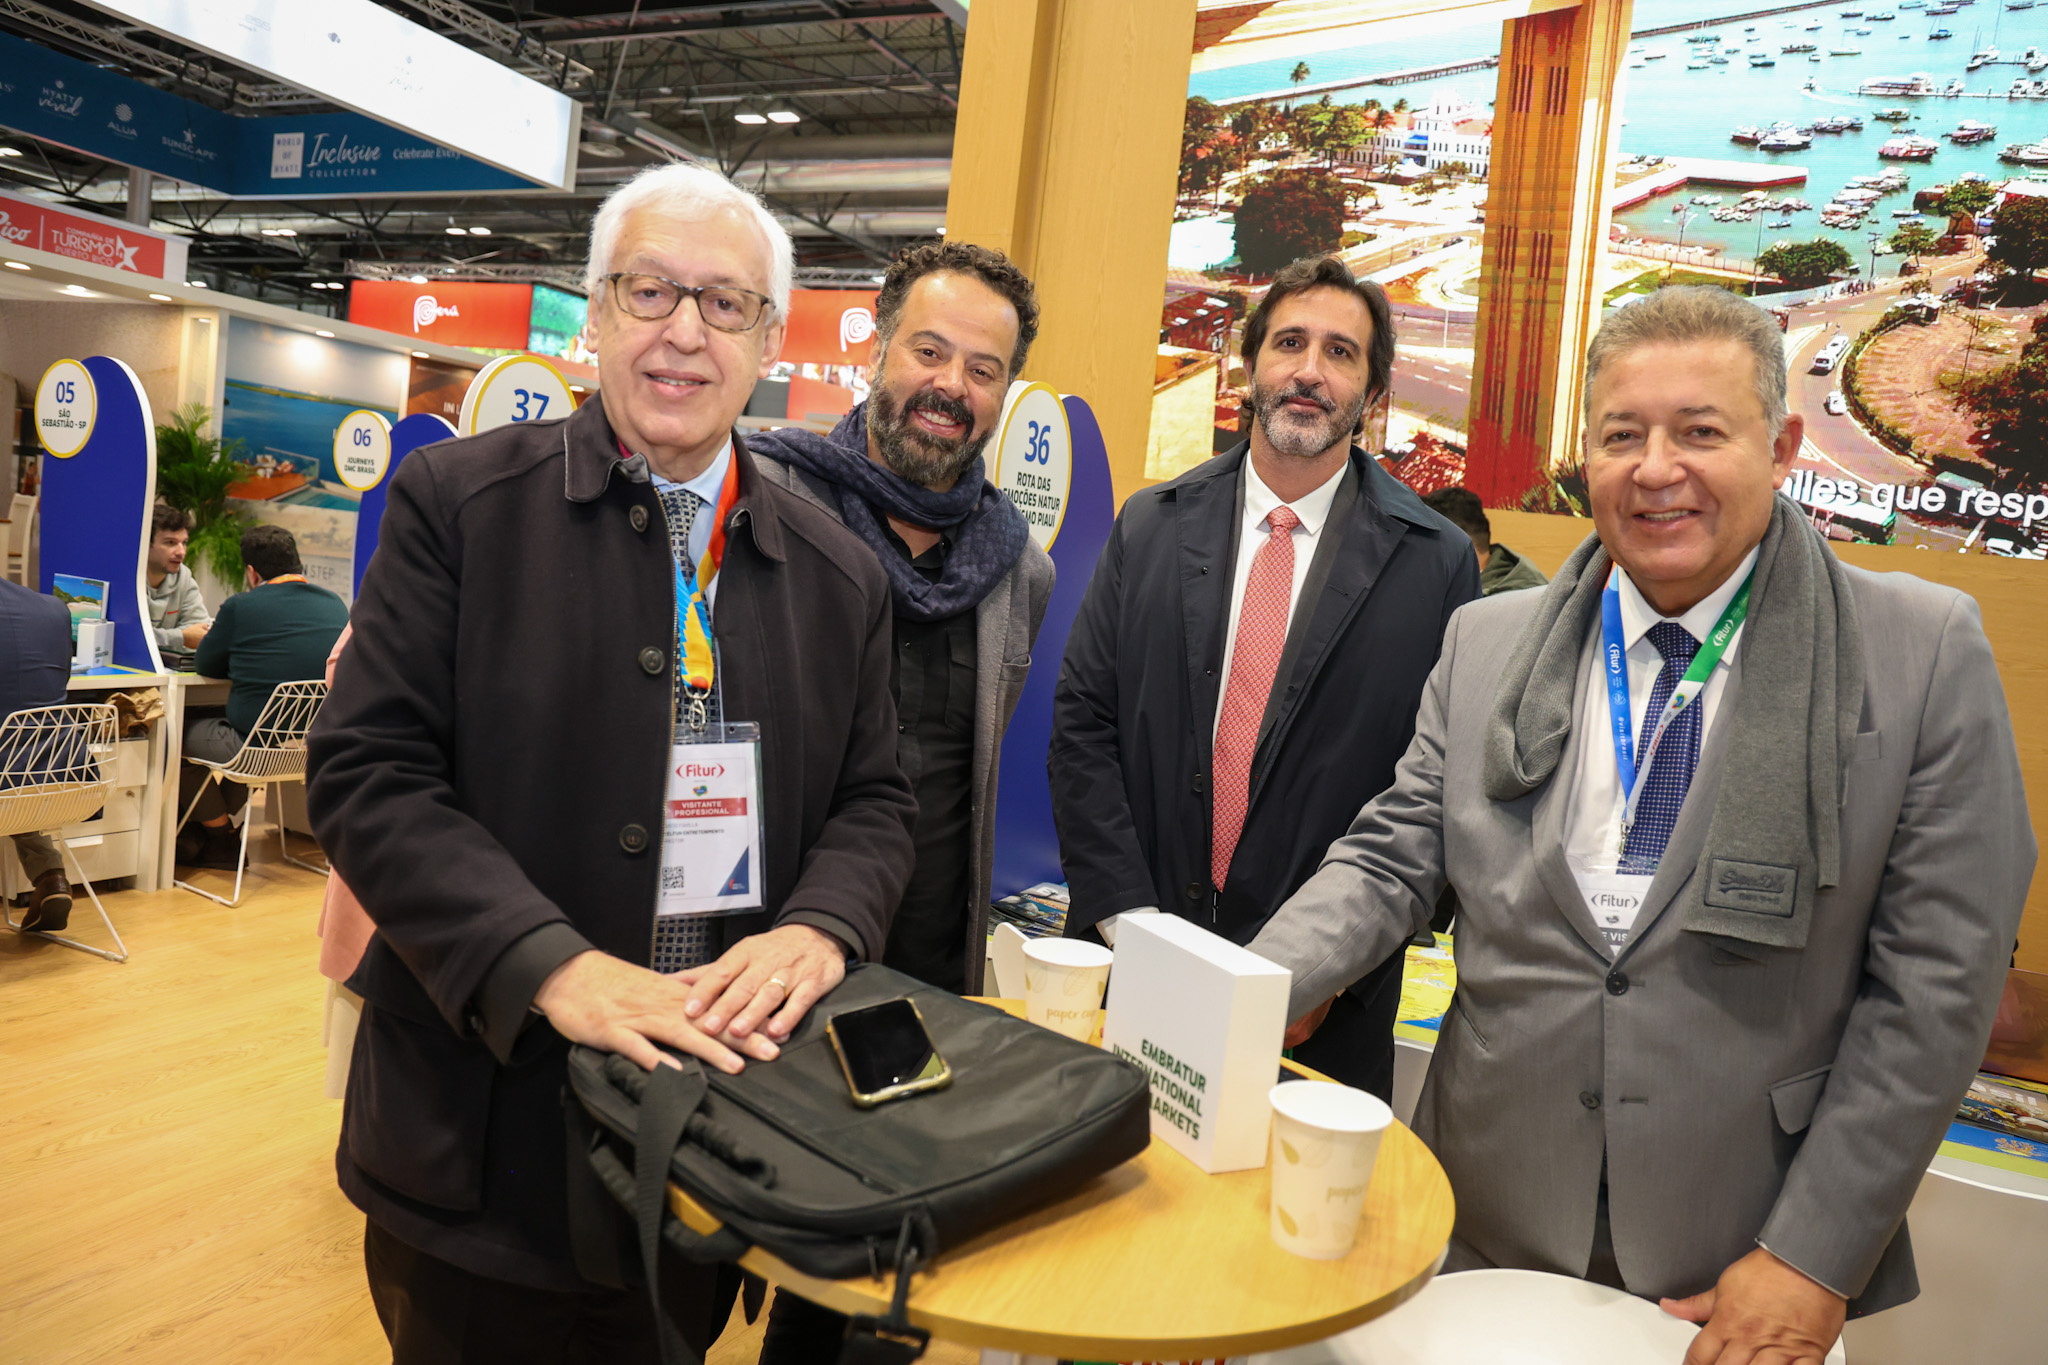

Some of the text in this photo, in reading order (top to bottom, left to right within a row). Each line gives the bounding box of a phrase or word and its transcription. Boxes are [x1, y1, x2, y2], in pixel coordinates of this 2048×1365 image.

[107, 121, 138, 137] ALUA
[276, 137, 300, 146] WORLD
[282, 151, 292, 159] OF
[306, 133, 382, 168] Inclusive
[392, 148, 434, 160] Celebrate
[274, 164, 299, 173] HYATT
[309, 168, 377, 178] COLLECTION
[51, 229, 115, 258] TURISMO
[55, 245, 114, 267] PUERTO RICO
[56, 381, 75, 403] 05
[58, 408, 71, 418] SÃO
[511, 388, 550, 422] 37
[42, 418, 74, 428] SEBASTIÃO
[78, 420, 87, 429] SP
[353, 428, 371, 447] 06
[1024, 420, 1051, 466] 36
[347, 457, 375, 466] JOURNEYS
[357, 465, 376, 475] BRASIL
[1016, 471, 1051, 492] ROTA DAS
[1003, 487, 1060, 511] MOÇÕES NATUR
[1870, 482, 1947, 516] que
[1037, 511, 1056, 528] PIAUÍ
[310, 564, 336, 580] STEP
[685, 763, 717, 778] Fitur
[674, 808, 730, 817] PROFESIONAL
[681, 800, 722, 809] VISITANTE
[1600, 894, 1631, 908] Fitur
[1046, 1008, 1078, 1024] paper
[1141, 1038, 1206, 1094] EMBRATUR
